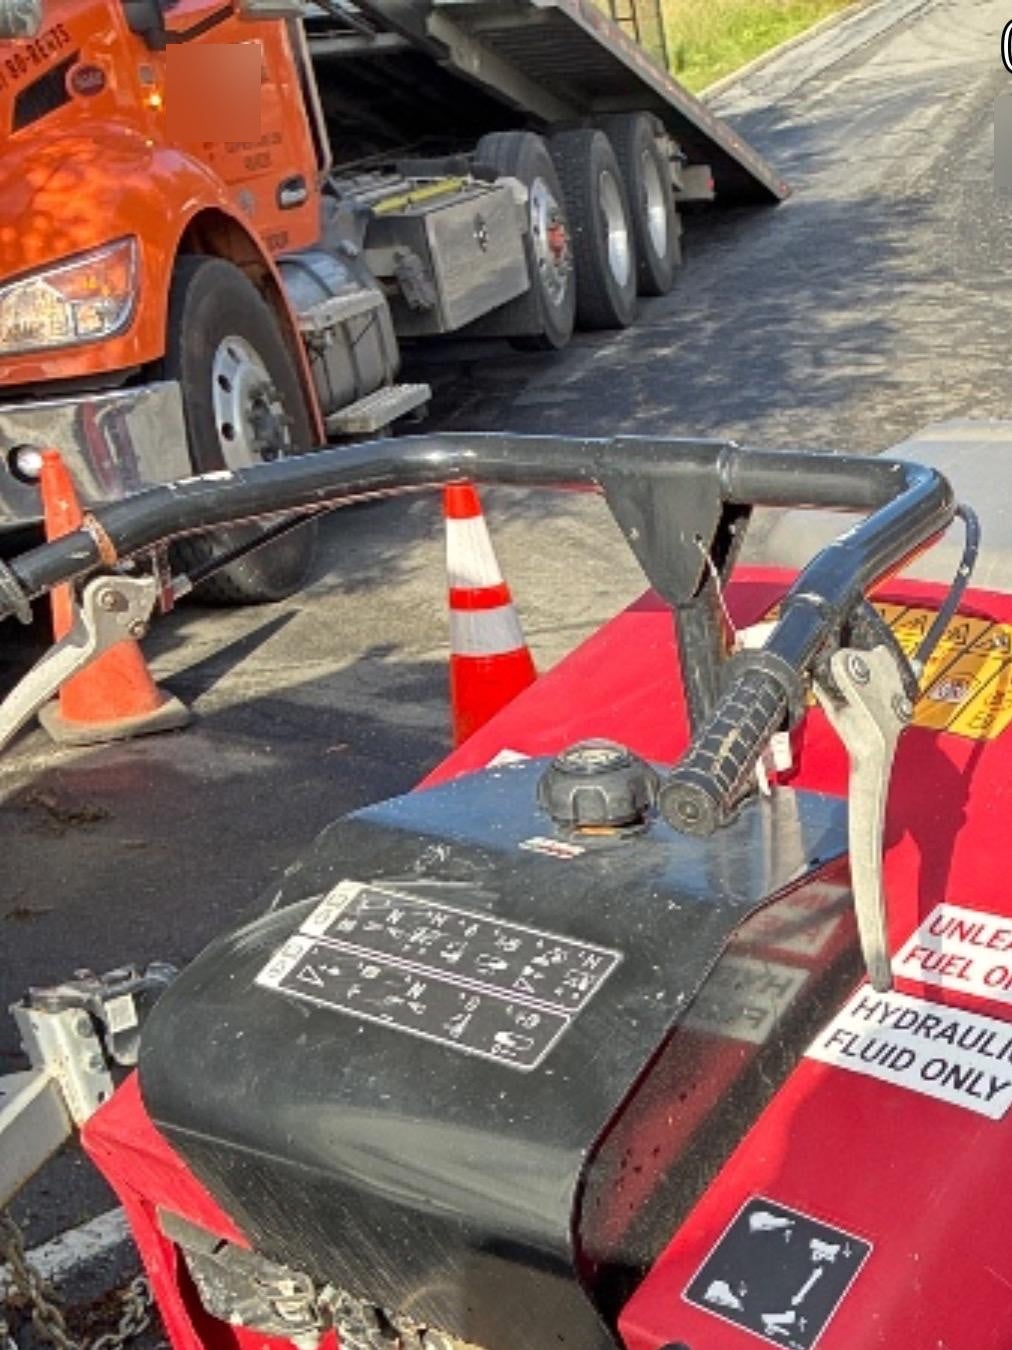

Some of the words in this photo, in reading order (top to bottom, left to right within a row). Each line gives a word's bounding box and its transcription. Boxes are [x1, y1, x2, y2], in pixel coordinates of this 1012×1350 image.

[902, 944, 974, 981] FUEL
[824, 1028, 916, 1071] FLUID
[920, 1058, 1012, 1102] ONLY
